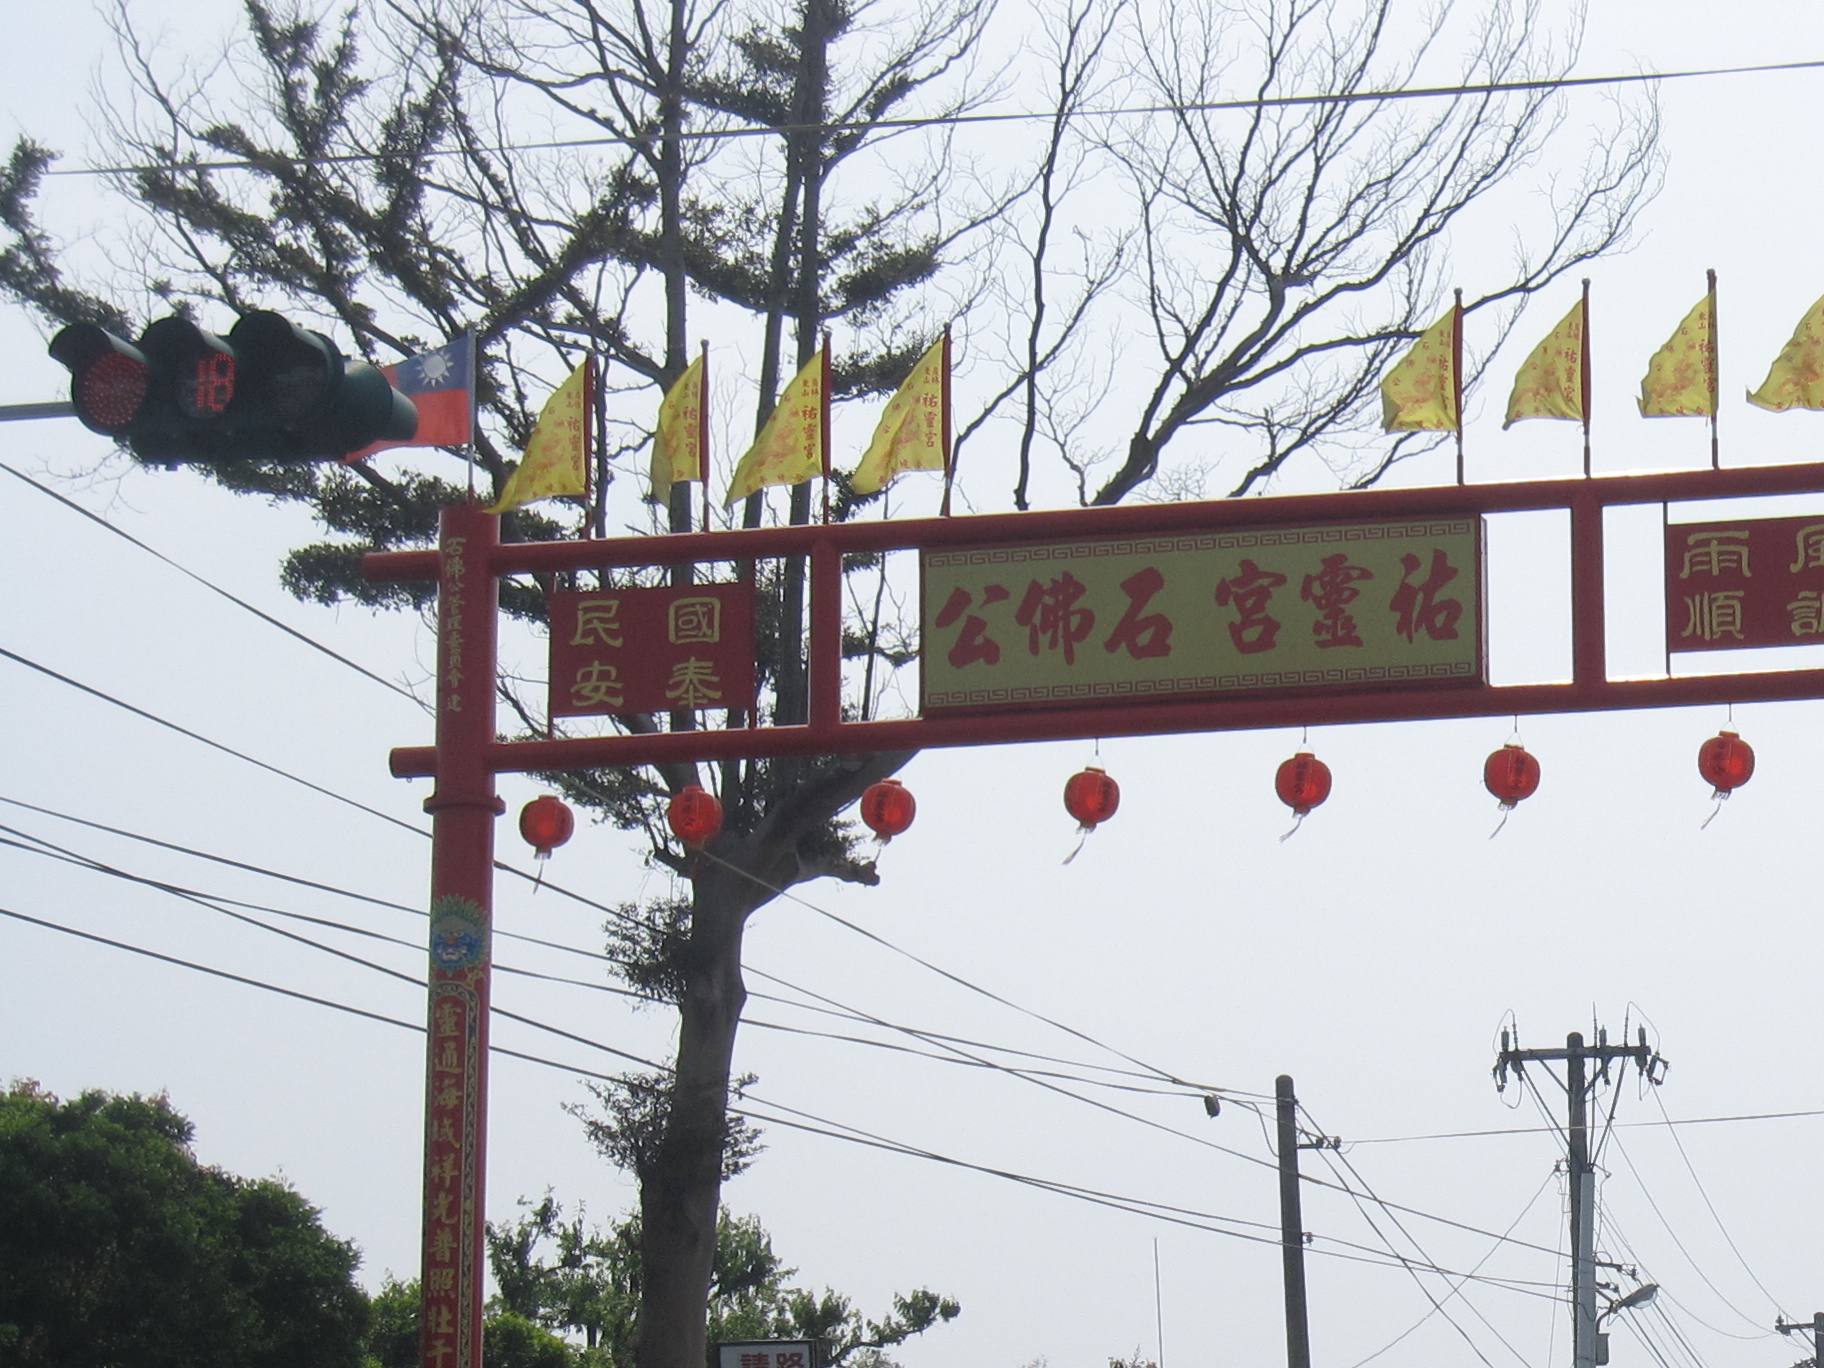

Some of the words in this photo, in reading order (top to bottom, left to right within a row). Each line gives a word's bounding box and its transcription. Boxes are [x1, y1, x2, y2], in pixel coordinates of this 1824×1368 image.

[1680, 529, 1751, 641] 雨順
[570, 597, 624, 708] 民安
[665, 596, 722, 710] 國泰
